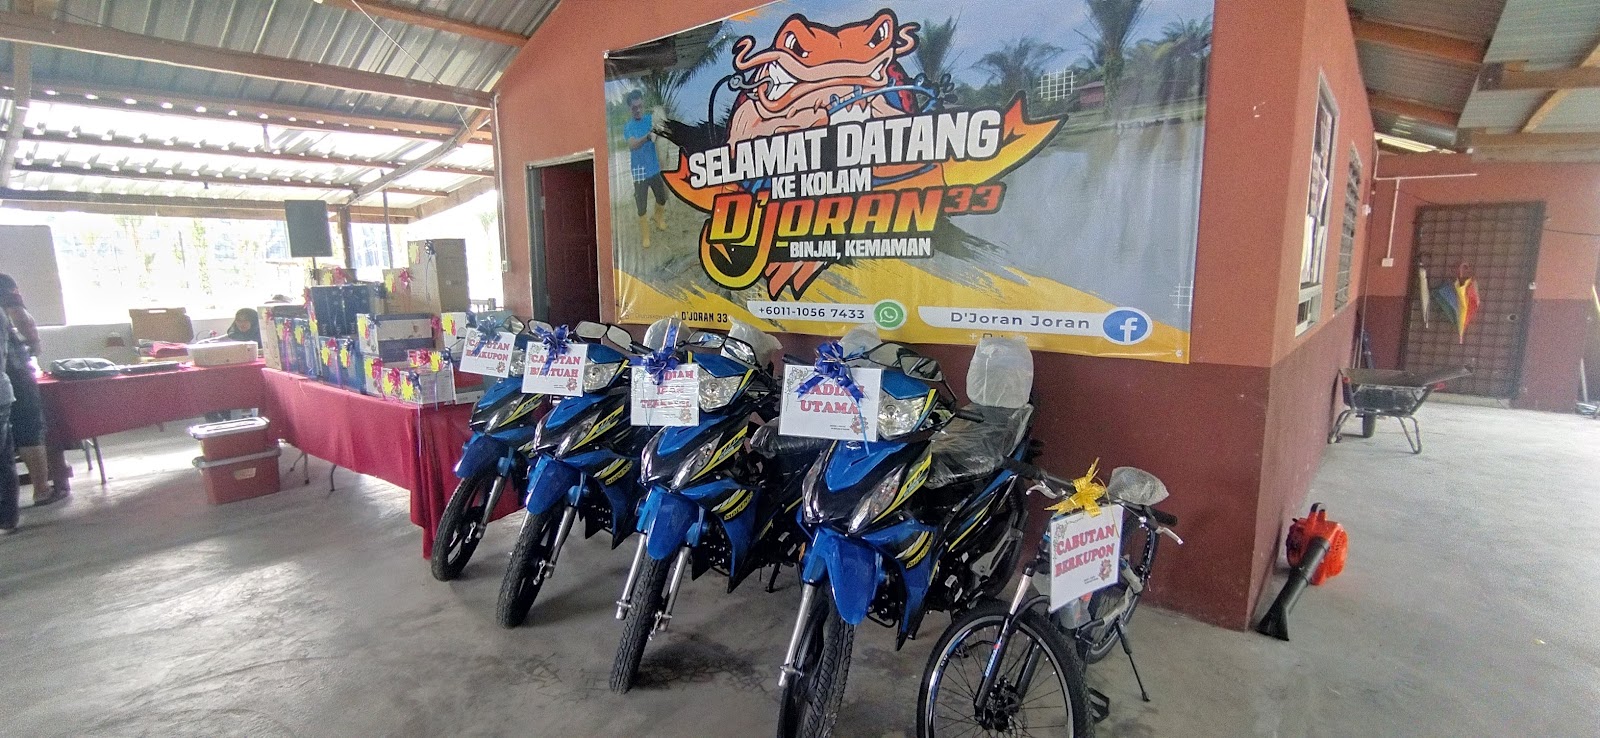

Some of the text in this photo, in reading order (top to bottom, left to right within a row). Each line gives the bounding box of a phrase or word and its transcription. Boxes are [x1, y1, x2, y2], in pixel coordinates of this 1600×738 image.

[688, 110, 1001, 188] SELAMAT DATANG
[771, 167, 871, 199] KE KOLAM
[944, 185, 1001, 213] 33
[790, 237, 931, 260] BINJAI, KEMAMAN
[681, 311, 714, 323] D'JORAN
[716, 313, 728, 323] 33
[758, 306, 865, 319] +6011-1056 7433
[950, 311, 1090, 329] D'Joran Joran
[800, 400, 861, 414] UTAMA
[1056, 524, 1115, 556] CABUTAN
[1055, 543, 1115, 577] BERKUPON
